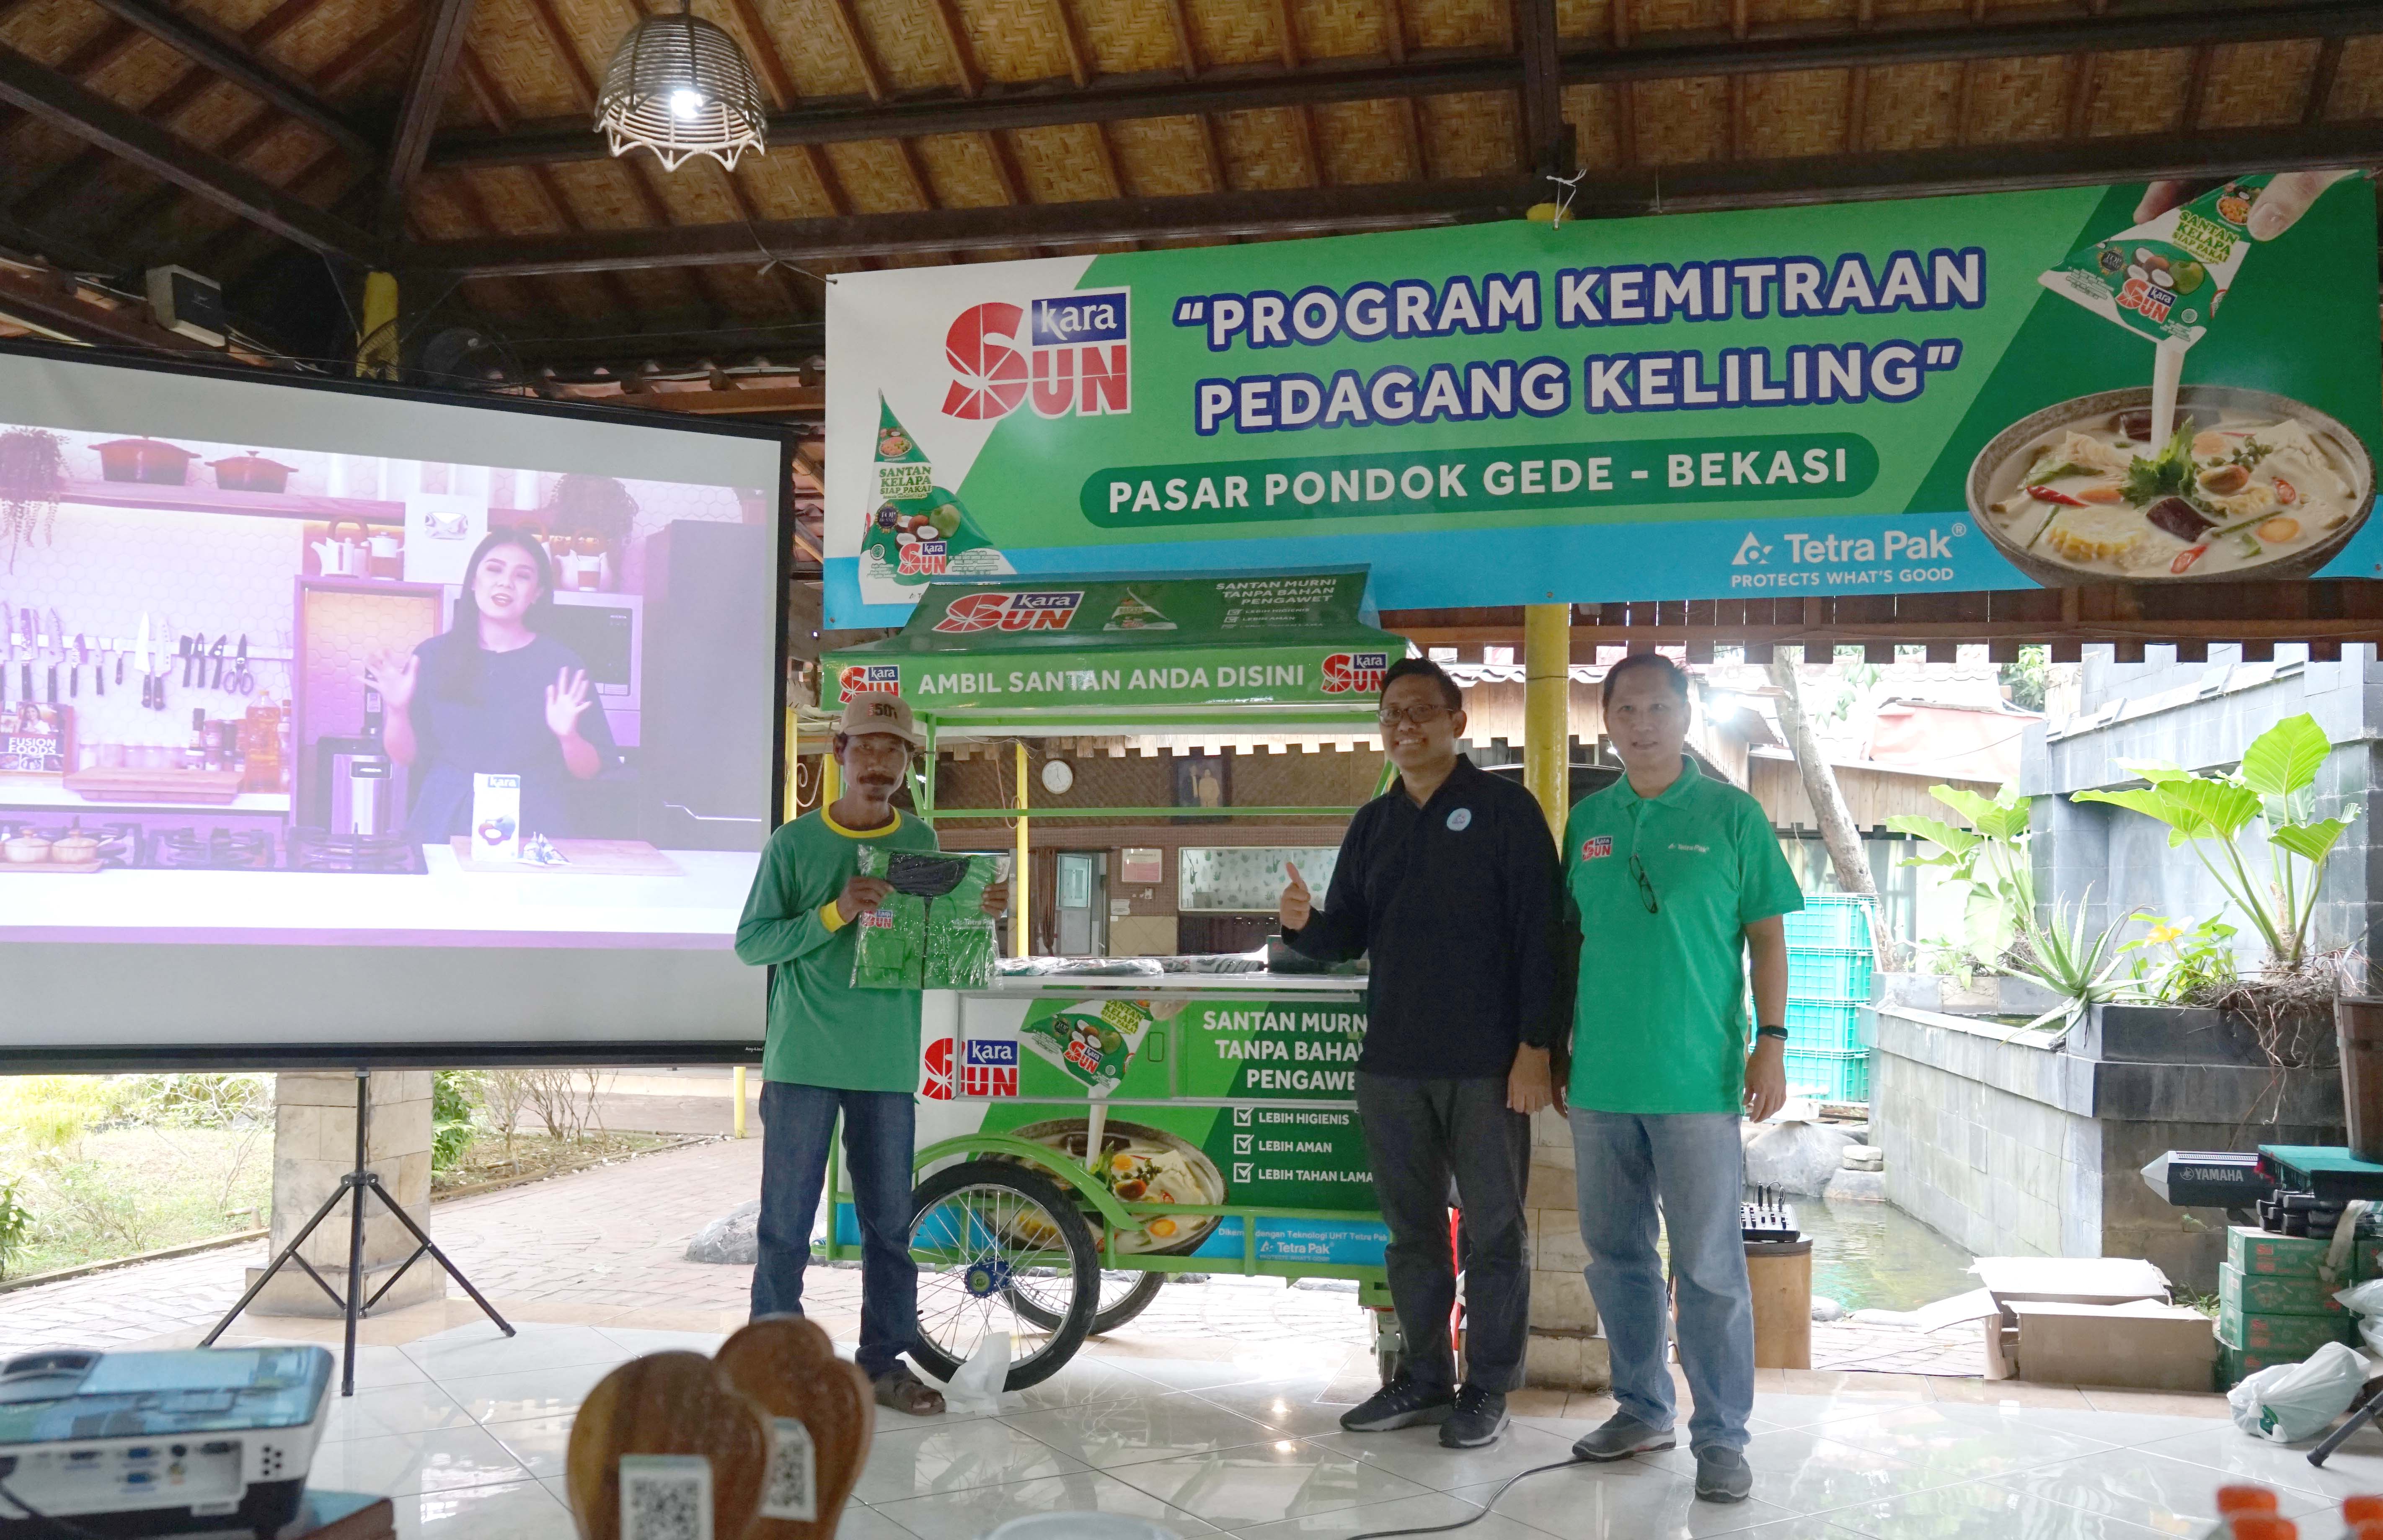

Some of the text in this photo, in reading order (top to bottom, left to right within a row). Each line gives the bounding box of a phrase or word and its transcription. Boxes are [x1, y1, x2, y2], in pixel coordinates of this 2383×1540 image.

[2176, 222, 2231, 255] KELAPA
[2179, 211, 2239, 245] SANTAN
[2172, 232, 2196, 246] SIAP
[2197, 244, 2229, 262] PAKAI
[1561, 253, 1980, 322] KEMITRAAN
[2150, 286, 2173, 304] kara
[2115, 278, 2170, 323] SUN
[1041, 299, 1119, 341] kara
[941, 302, 1128, 420] SUN
[1200, 362, 1565, 431] PEDAGANG
[879, 466, 932, 478] SANTAN
[881, 475, 932, 488] KELAPA
[1109, 447, 1846, 513] PASAR PONDOK GEDE - BEKASI
[903, 485, 932, 493] PAKAI
[923, 544, 944, 555] kara
[1784, 531, 1875, 564] Tetra
[897, 542, 946, 576] SUN
[1215, 579, 1337, 590] SANTAN MURNI
[1731, 567, 1954, 587] PROTECTS WHAT'S GOOD
[1018, 593, 1072, 609] kara
[1241, 595, 1334, 605] PENGAWET
[1277, 587, 1334, 596] BAHAN
[932, 593, 1074, 632] SUN
[1356, 655, 1383, 668] kara
[871, 667, 896, 680] kara
[918, 665, 1303, 695] AMBIL SANTAN ANDA DISINI
[1322, 654, 1386, 692] SUN
[8, 745, 56, 754] FOODS
[9, 737, 57, 747] FUSION
[489, 777, 517, 787] kara
[1583, 840, 1611, 862] SUN
[1101, 1010, 1116, 1021] SIAP
[1116, 1019, 1137, 1034] PAKAI
[1103, 1002, 1139, 1030] KELAPA
[1203, 1010, 1368, 1033] SANTAN MURN
[971, 1042, 1013, 1064] kara
[1064, 1040, 1098, 1074] SUN
[1086, 1048, 1100, 1061] kara
[1215, 1039, 1290, 1060] TANPA
[921, 1037, 1018, 1101] SUN
[1246, 1068, 1355, 1091] PENGAWE
[1258, 1111, 1350, 1126] LEBIH HIGIENIS
[1258, 1140, 1333, 1153] LEBIH AMAN
[1258, 1168, 1374, 1183] LEBIH TAHAN LAMA
[2194, 1167, 2244, 1182] YAMAHA
[1218, 1228, 1245, 1236] Dikem
[1255, 1230, 1286, 1240] dengan
[1287, 1230, 1328, 1241] Teknologi
[1328, 1231, 1348, 1240] UHT
[1277, 1241, 1306, 1254] Tetra
